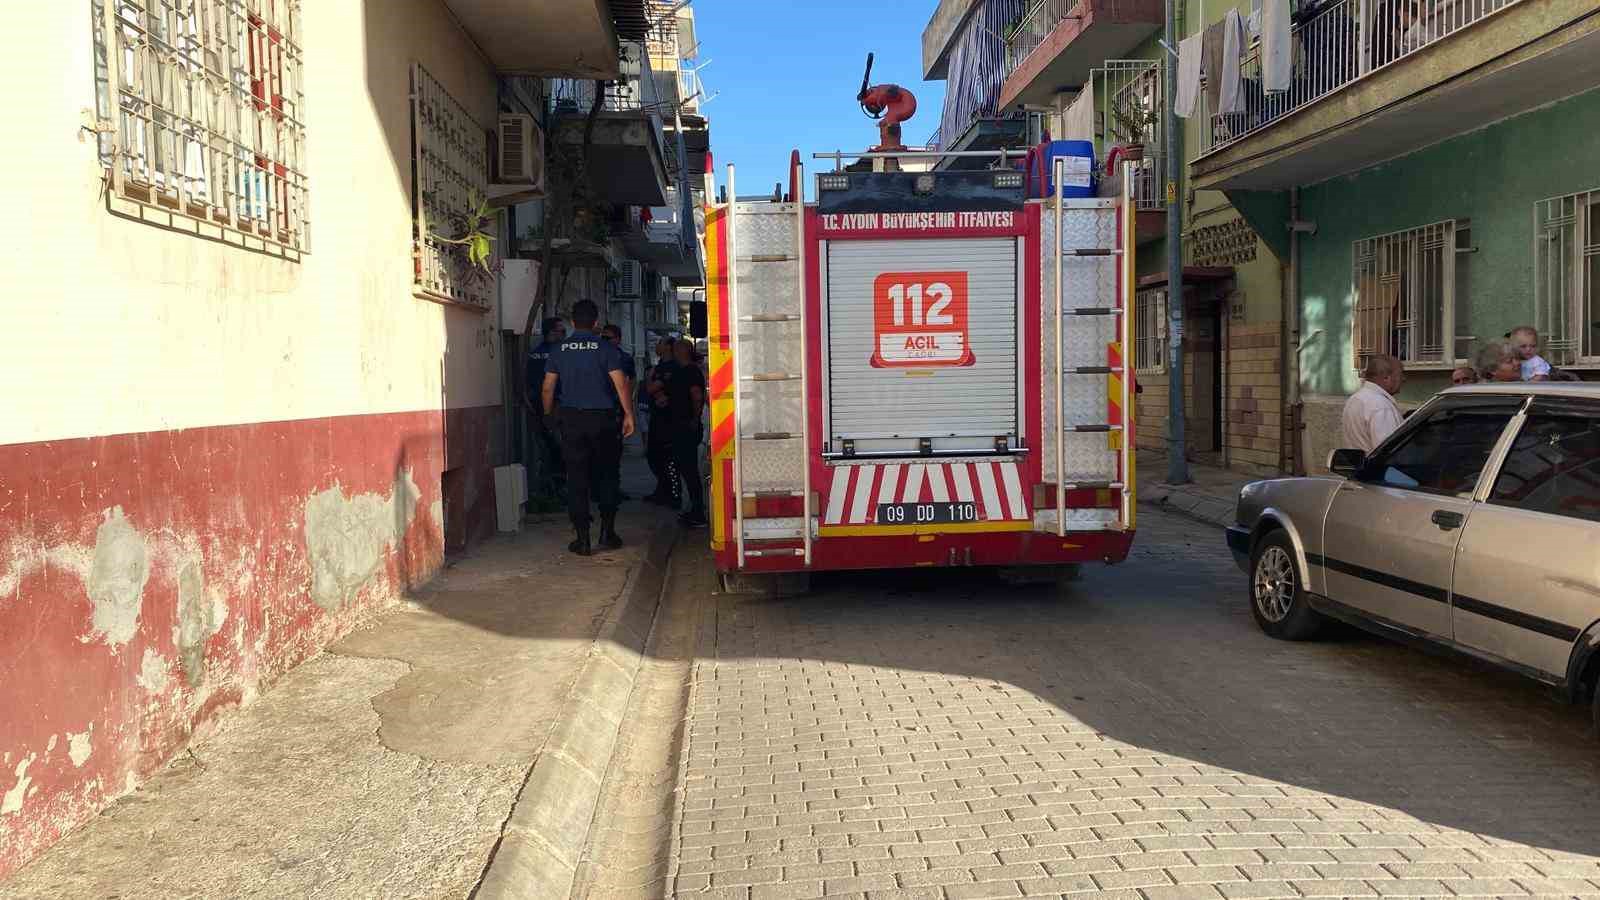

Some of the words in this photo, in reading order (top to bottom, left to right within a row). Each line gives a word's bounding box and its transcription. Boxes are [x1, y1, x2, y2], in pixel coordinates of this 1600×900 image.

[888, 282, 953, 326] 112
[887, 506, 904, 521] 09
[917, 505, 934, 521] DD
[948, 504, 973, 520] 110
